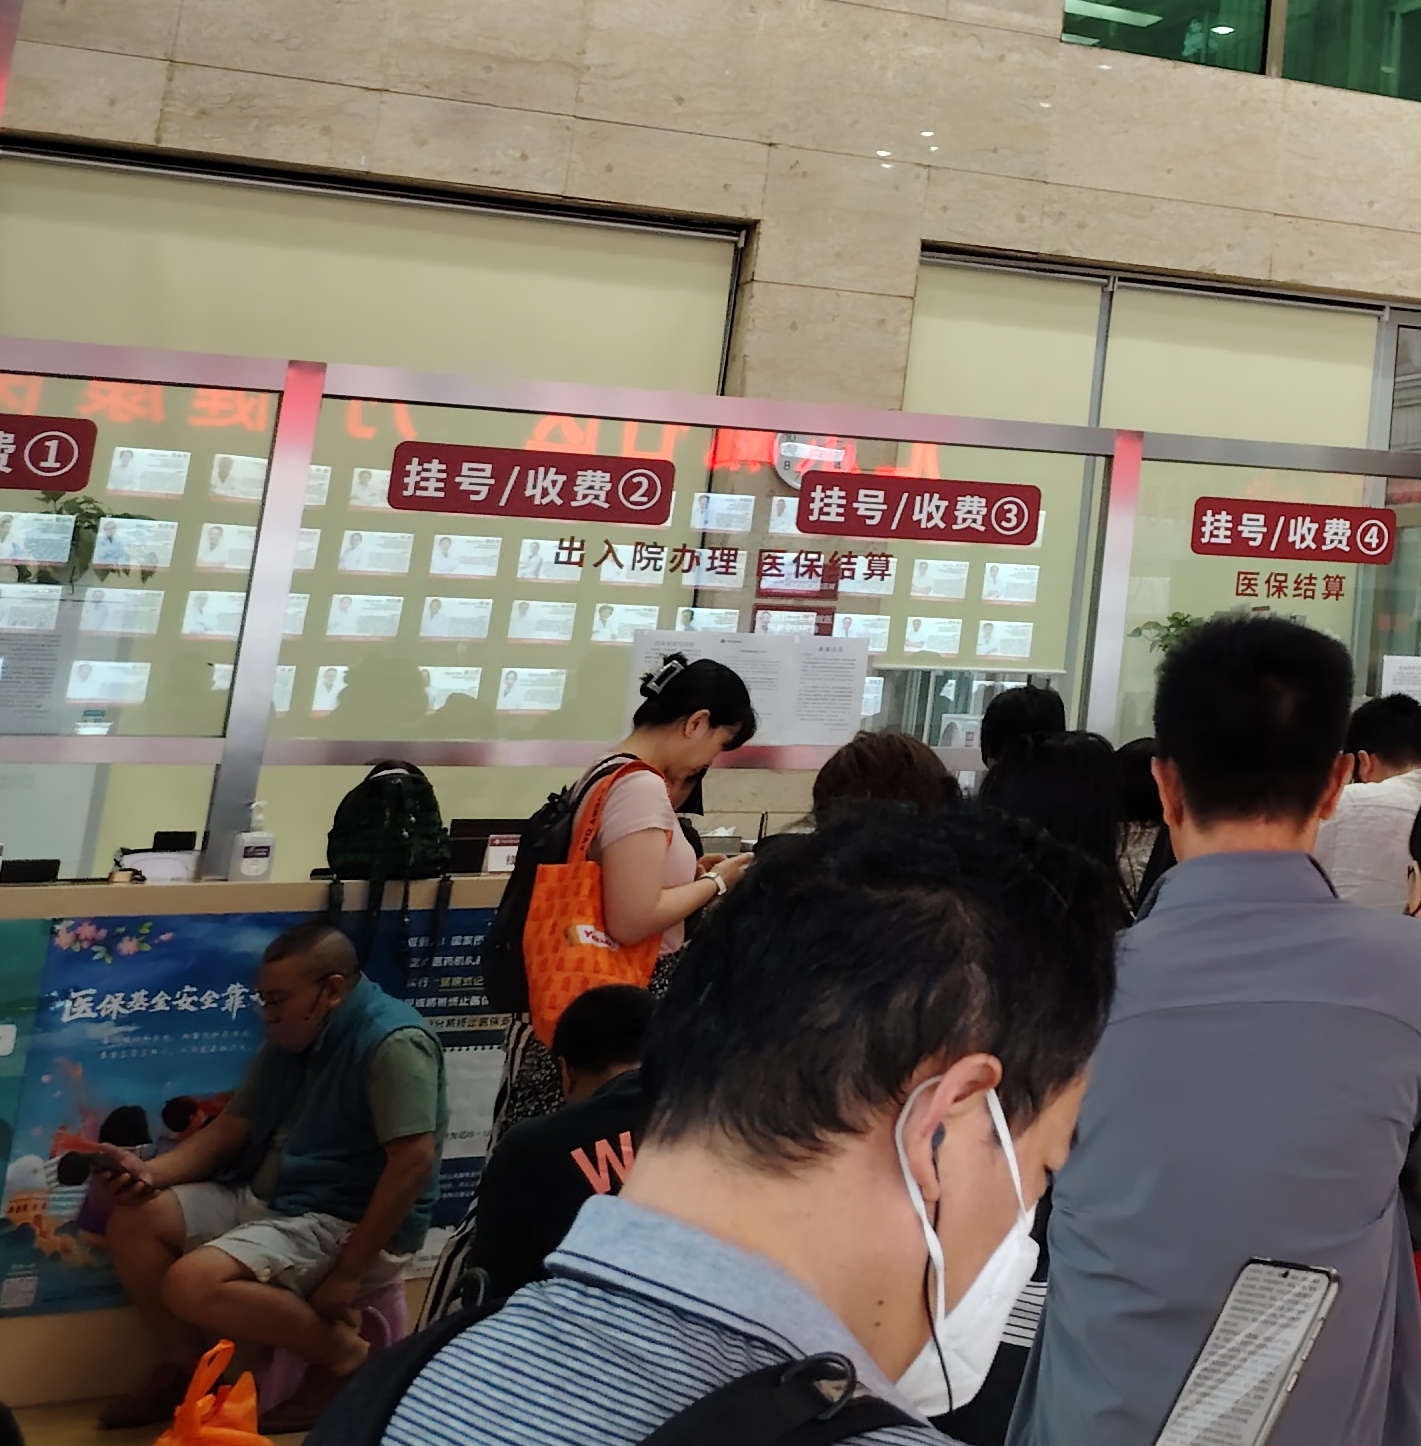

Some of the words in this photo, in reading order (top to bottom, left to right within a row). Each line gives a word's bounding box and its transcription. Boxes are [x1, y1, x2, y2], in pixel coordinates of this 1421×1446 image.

[402, 456, 662, 510] 挂号/收费②
[808, 484, 1029, 536] 挂号/收费③
[1200, 509, 1389, 555] 挂号/收费④
[553, 535, 739, 576] 出入院办理
[756, 548, 894, 582] 医保结算
[1235, 571, 1347, 601] 医保结算
